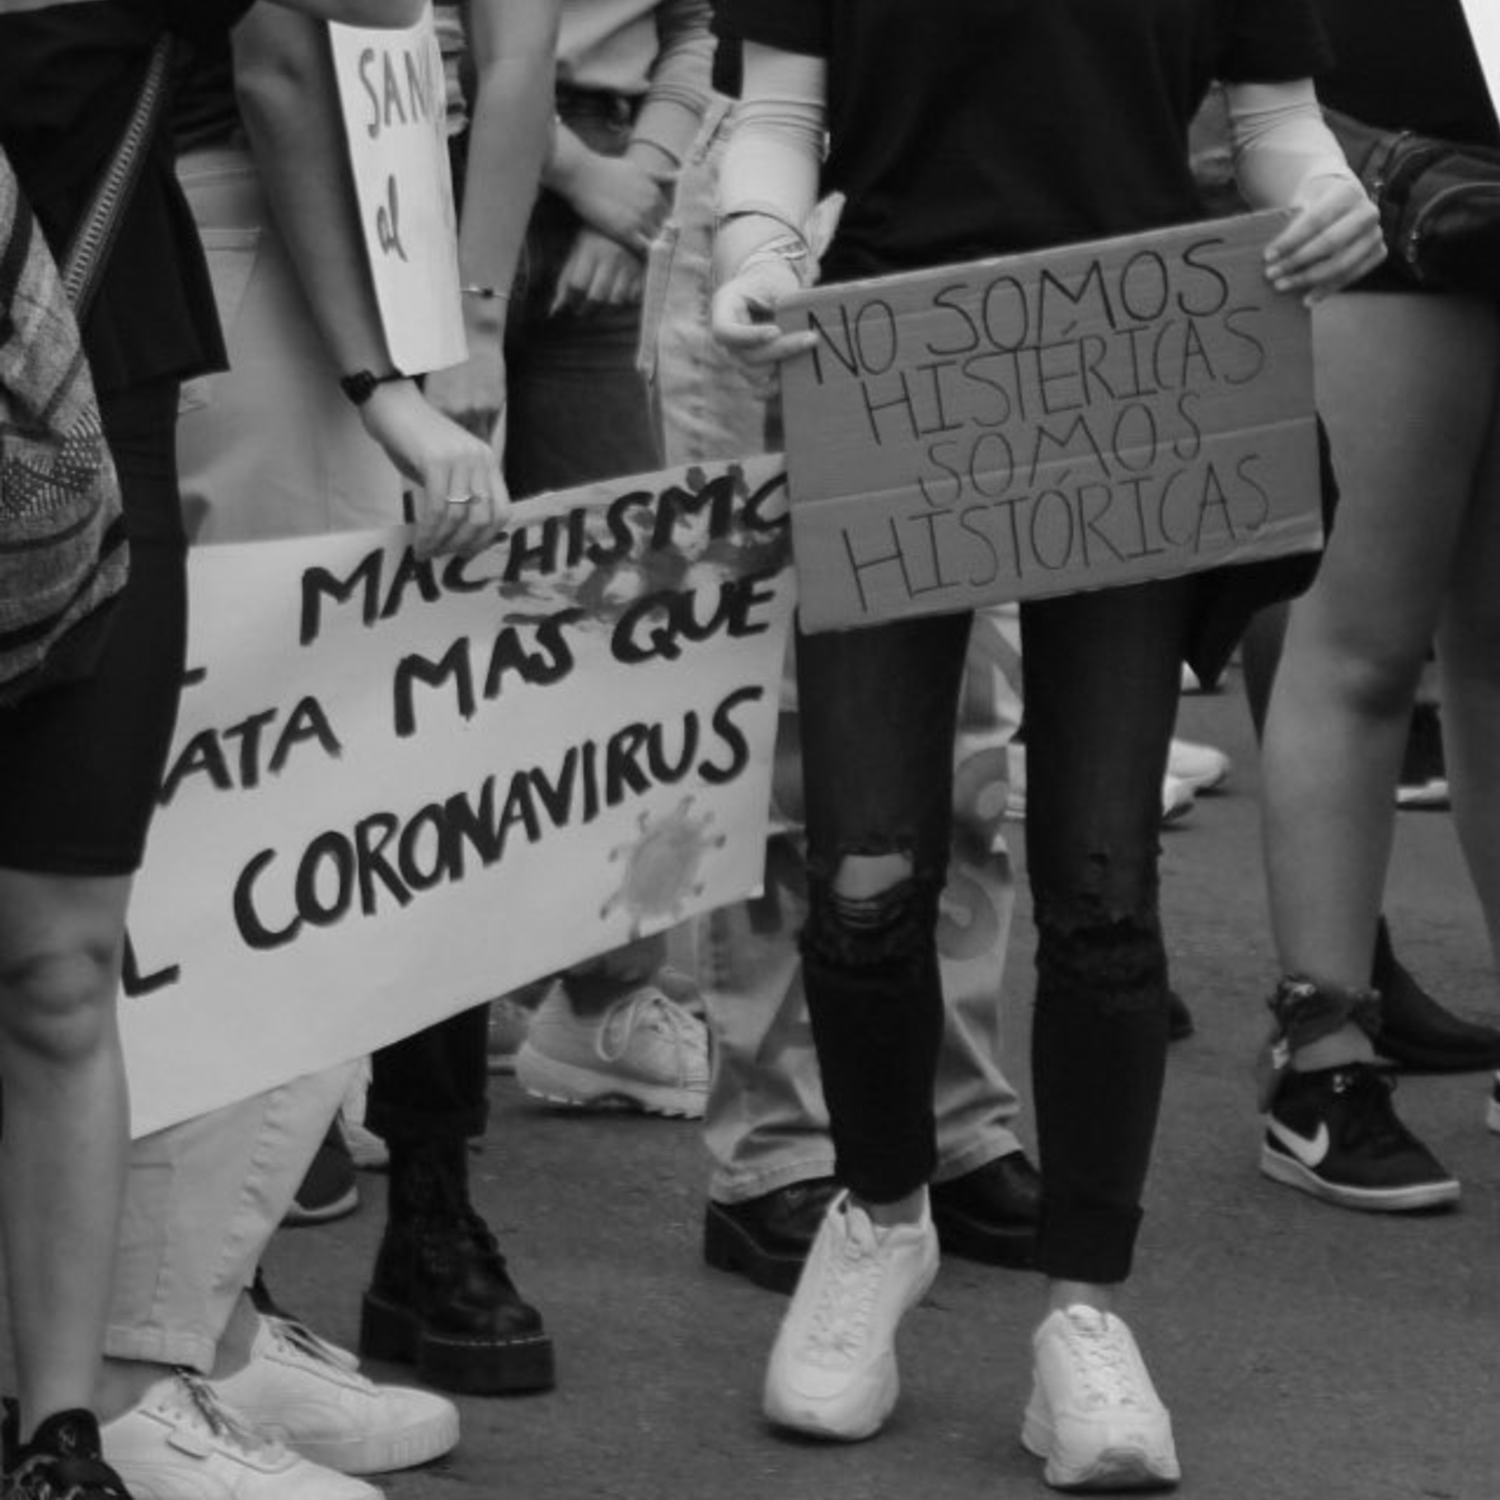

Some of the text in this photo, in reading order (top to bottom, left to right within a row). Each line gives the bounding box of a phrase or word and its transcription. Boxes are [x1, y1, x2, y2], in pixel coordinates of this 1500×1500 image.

[807, 237, 1229, 385] NO SOMOS
[917, 392, 1203, 508] SOMOS
[158, 695, 343, 807] ATA
[611, 568, 780, 664] QUE
[232, 685, 765, 950] CORONAVIRUS
